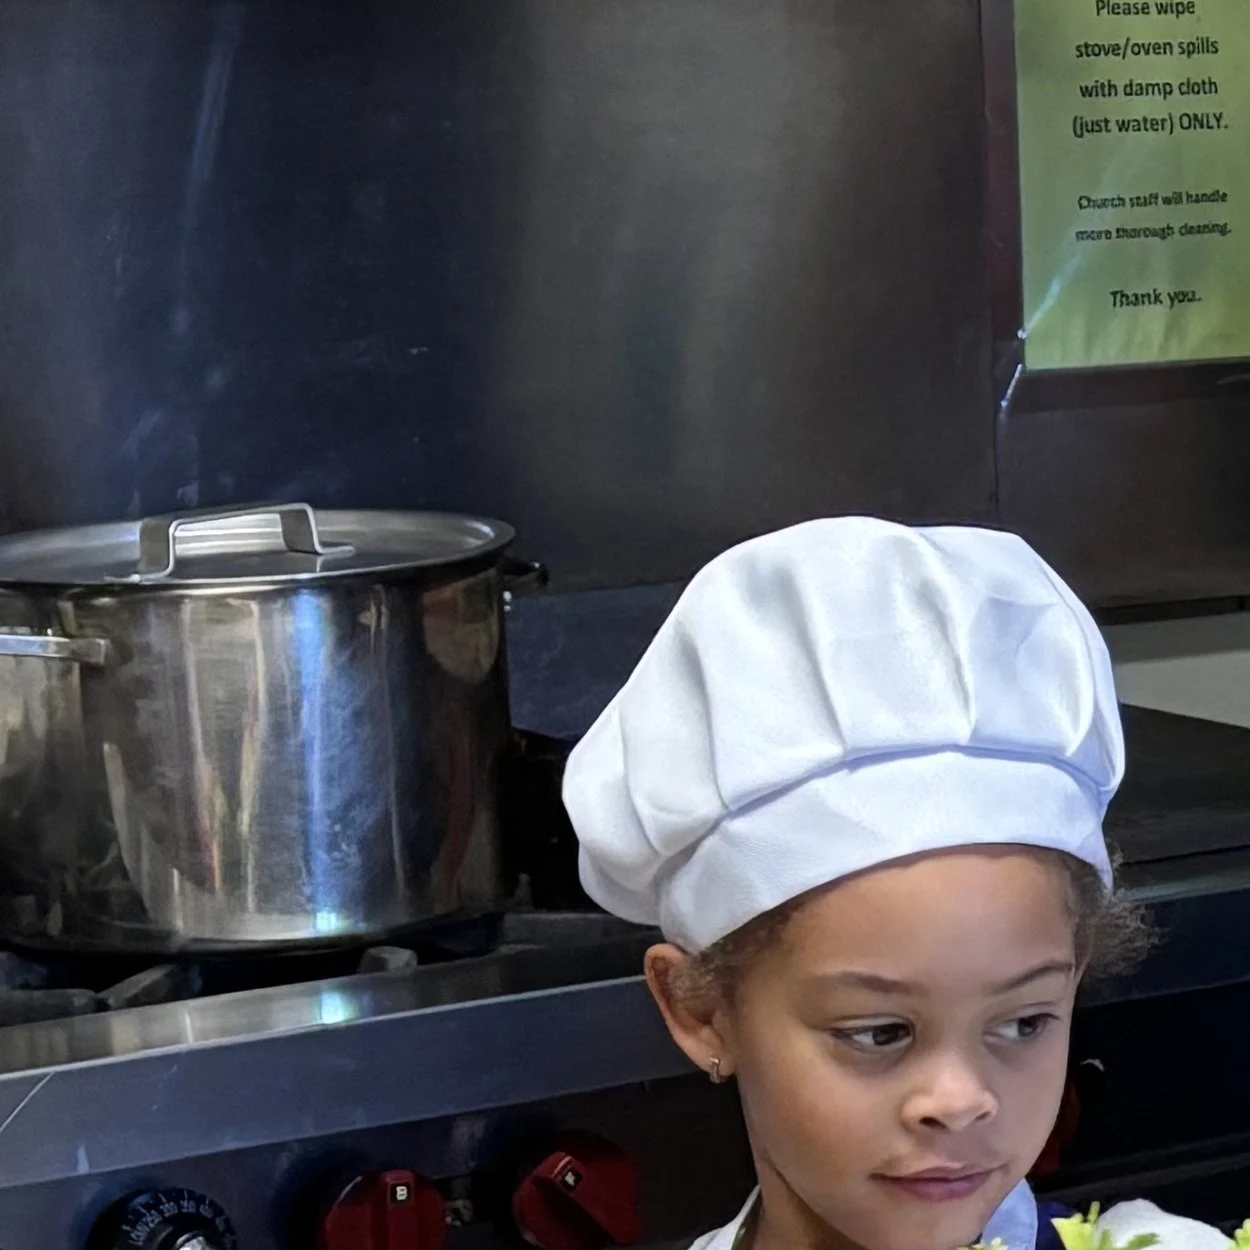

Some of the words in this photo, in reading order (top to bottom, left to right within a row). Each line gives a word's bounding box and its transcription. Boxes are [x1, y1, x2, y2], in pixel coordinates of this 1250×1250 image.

[1095, 0, 1151, 16] Please
[1155, 1, 1196, 18] wipe
[1075, 37, 1174, 60] stove/oven
[1178, 36, 1219, 59] spills
[1080, 80, 1118, 98] with
[1123, 78, 1174, 100] damp
[1178, 76, 1218, 96] cloth
[1072, 115, 1112, 138] (just
[1115, 113, 1174, 135] water)
[1179, 111, 1229, 130] ONLY.
[1078, 195, 1126, 210] Church
[1129, 192, 1159, 208] staff
[1162, 191, 1184, 206] will
[1186, 189, 1228, 204] handle
[1075, 229, 1112, 242] more
[1115, 224, 1175, 241] thorough
[1179, 222, 1232, 237] cleaning.
[1110, 288, 1163, 309] Thank
[1167, 290, 1203, 310] you.
